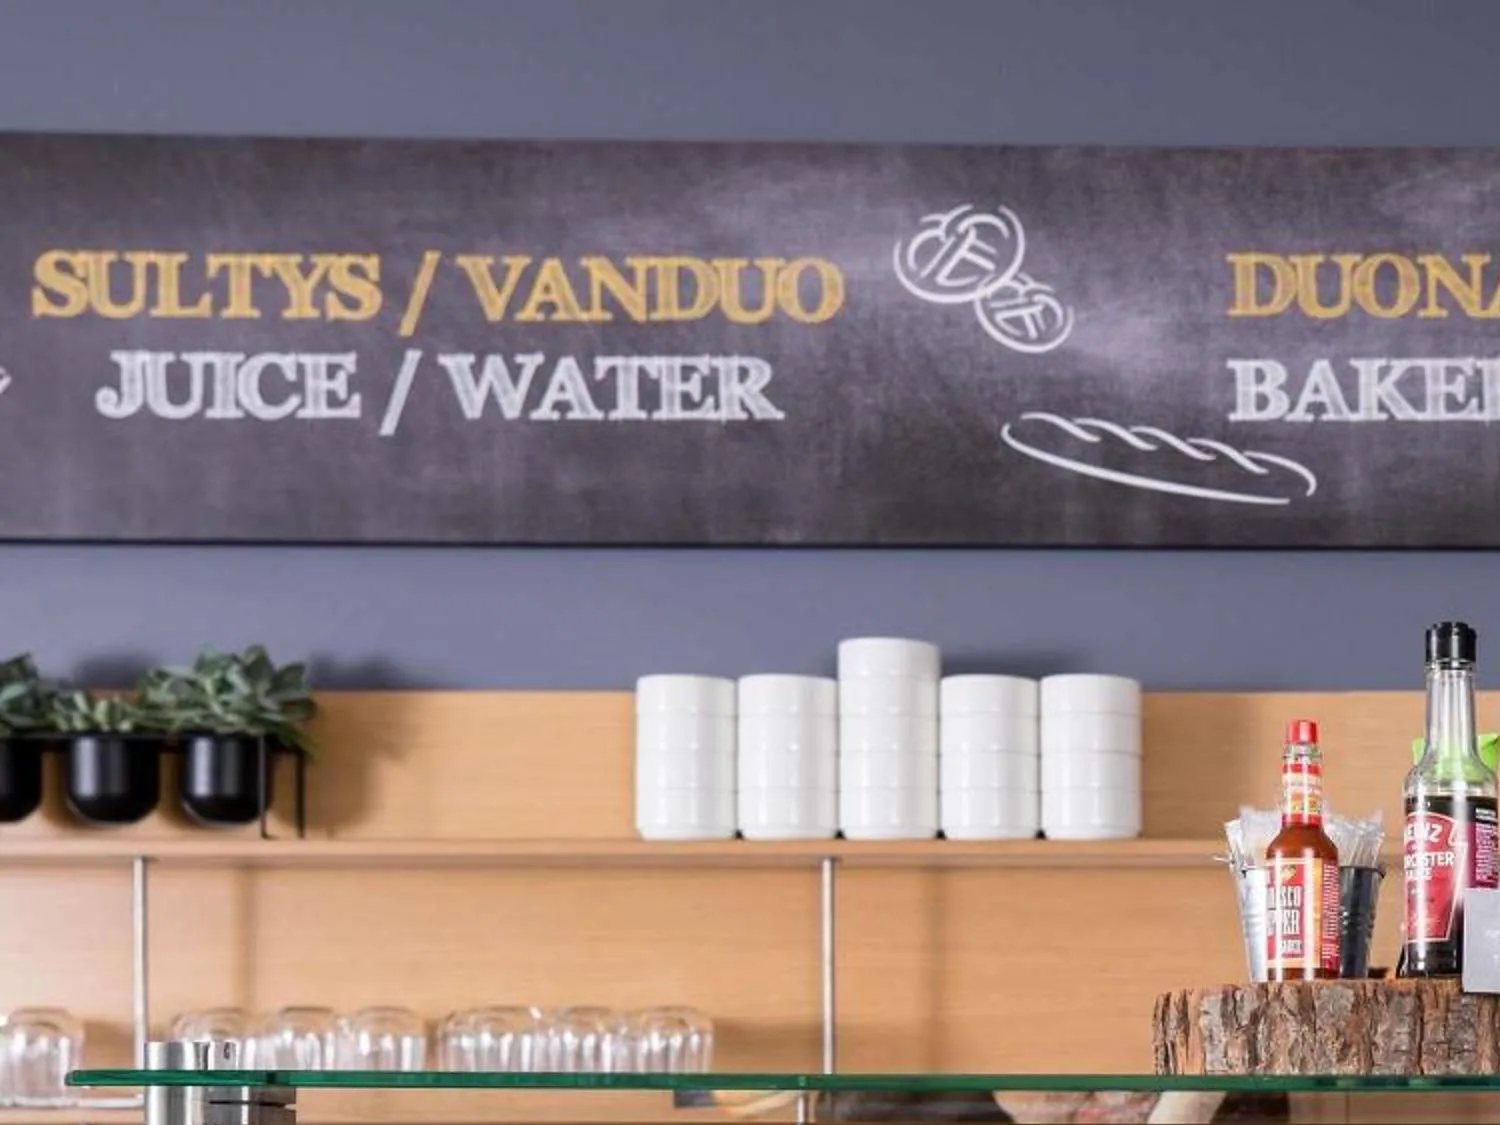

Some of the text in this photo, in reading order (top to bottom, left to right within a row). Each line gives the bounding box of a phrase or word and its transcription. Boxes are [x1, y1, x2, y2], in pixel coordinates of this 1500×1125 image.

[31, 249, 846, 335] SULTYS / VANDUO
[95, 350, 785, 435] JUICE / WATER
